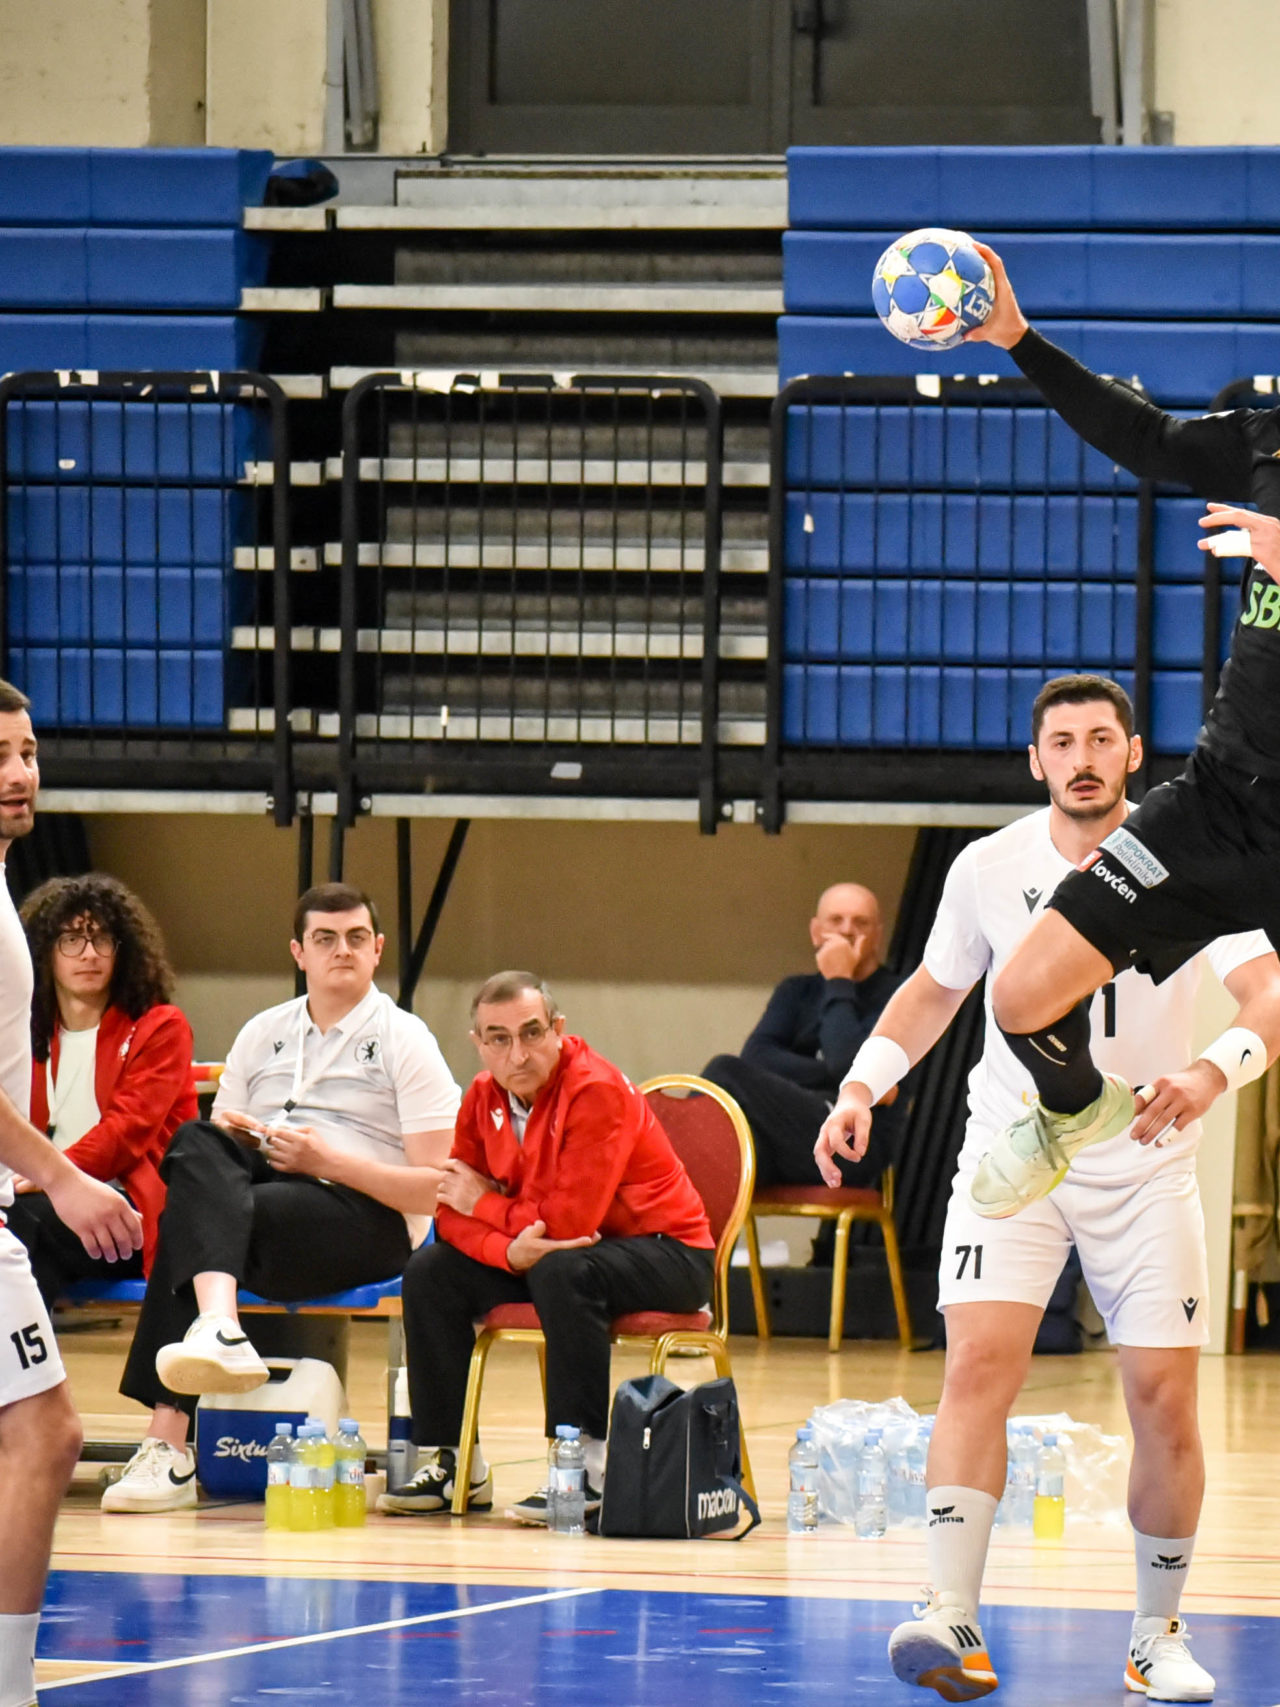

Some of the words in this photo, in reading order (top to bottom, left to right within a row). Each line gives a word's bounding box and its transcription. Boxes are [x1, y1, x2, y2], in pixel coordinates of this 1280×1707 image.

[1112, 844, 1154, 887] Poliklinika
[1122, 837, 1163, 879] HIPOKRAT
[1090, 860, 1137, 904] lovćen
[955, 1244, 984, 1280] 71
[10, 1322, 48, 1370] 15
[213, 1436, 269, 1463] Sixtu
[929, 1514, 965, 1527] erima
[1151, 1561, 1187, 1570] erima
